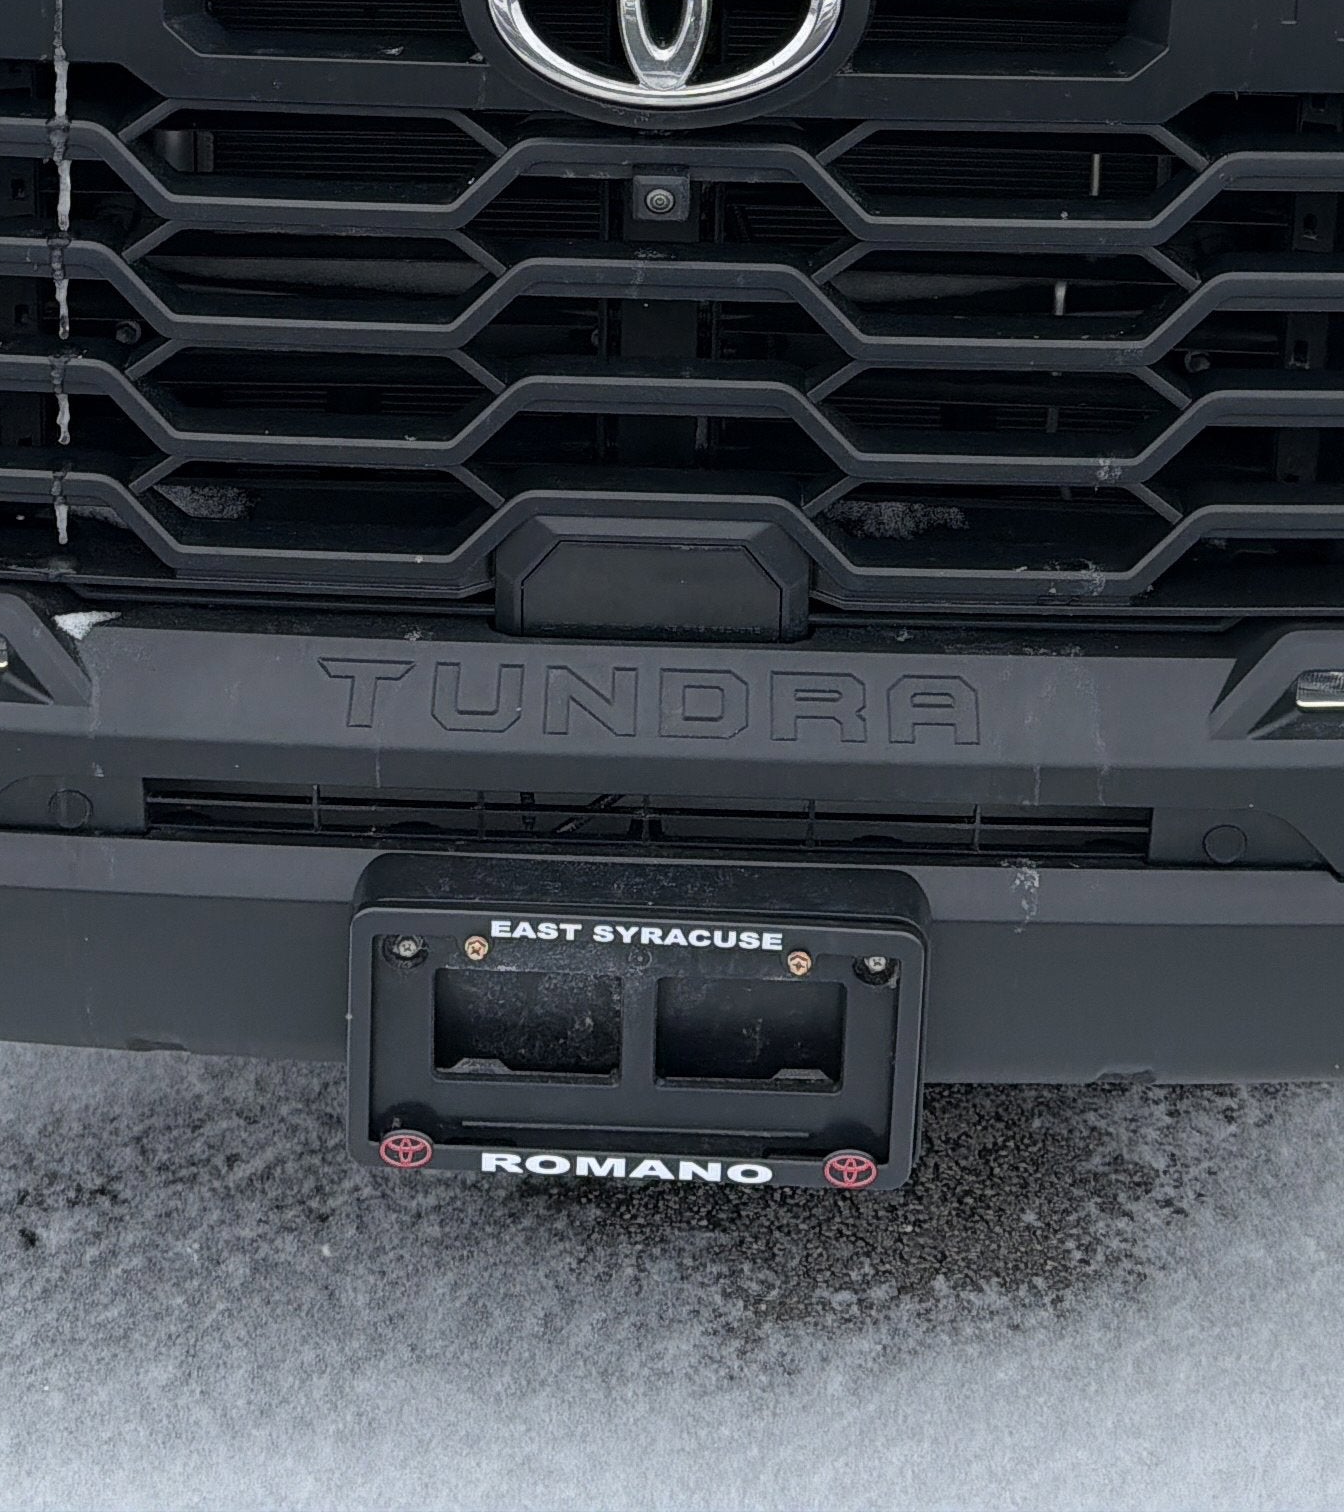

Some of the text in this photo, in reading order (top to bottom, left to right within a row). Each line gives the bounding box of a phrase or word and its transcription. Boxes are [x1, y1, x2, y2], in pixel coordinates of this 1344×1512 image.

[317, 657, 981, 746] TUNDRA
[490, 920, 783, 951] EAST SYRACUSE
[481, 1152, 773, 1185] ROMANO
